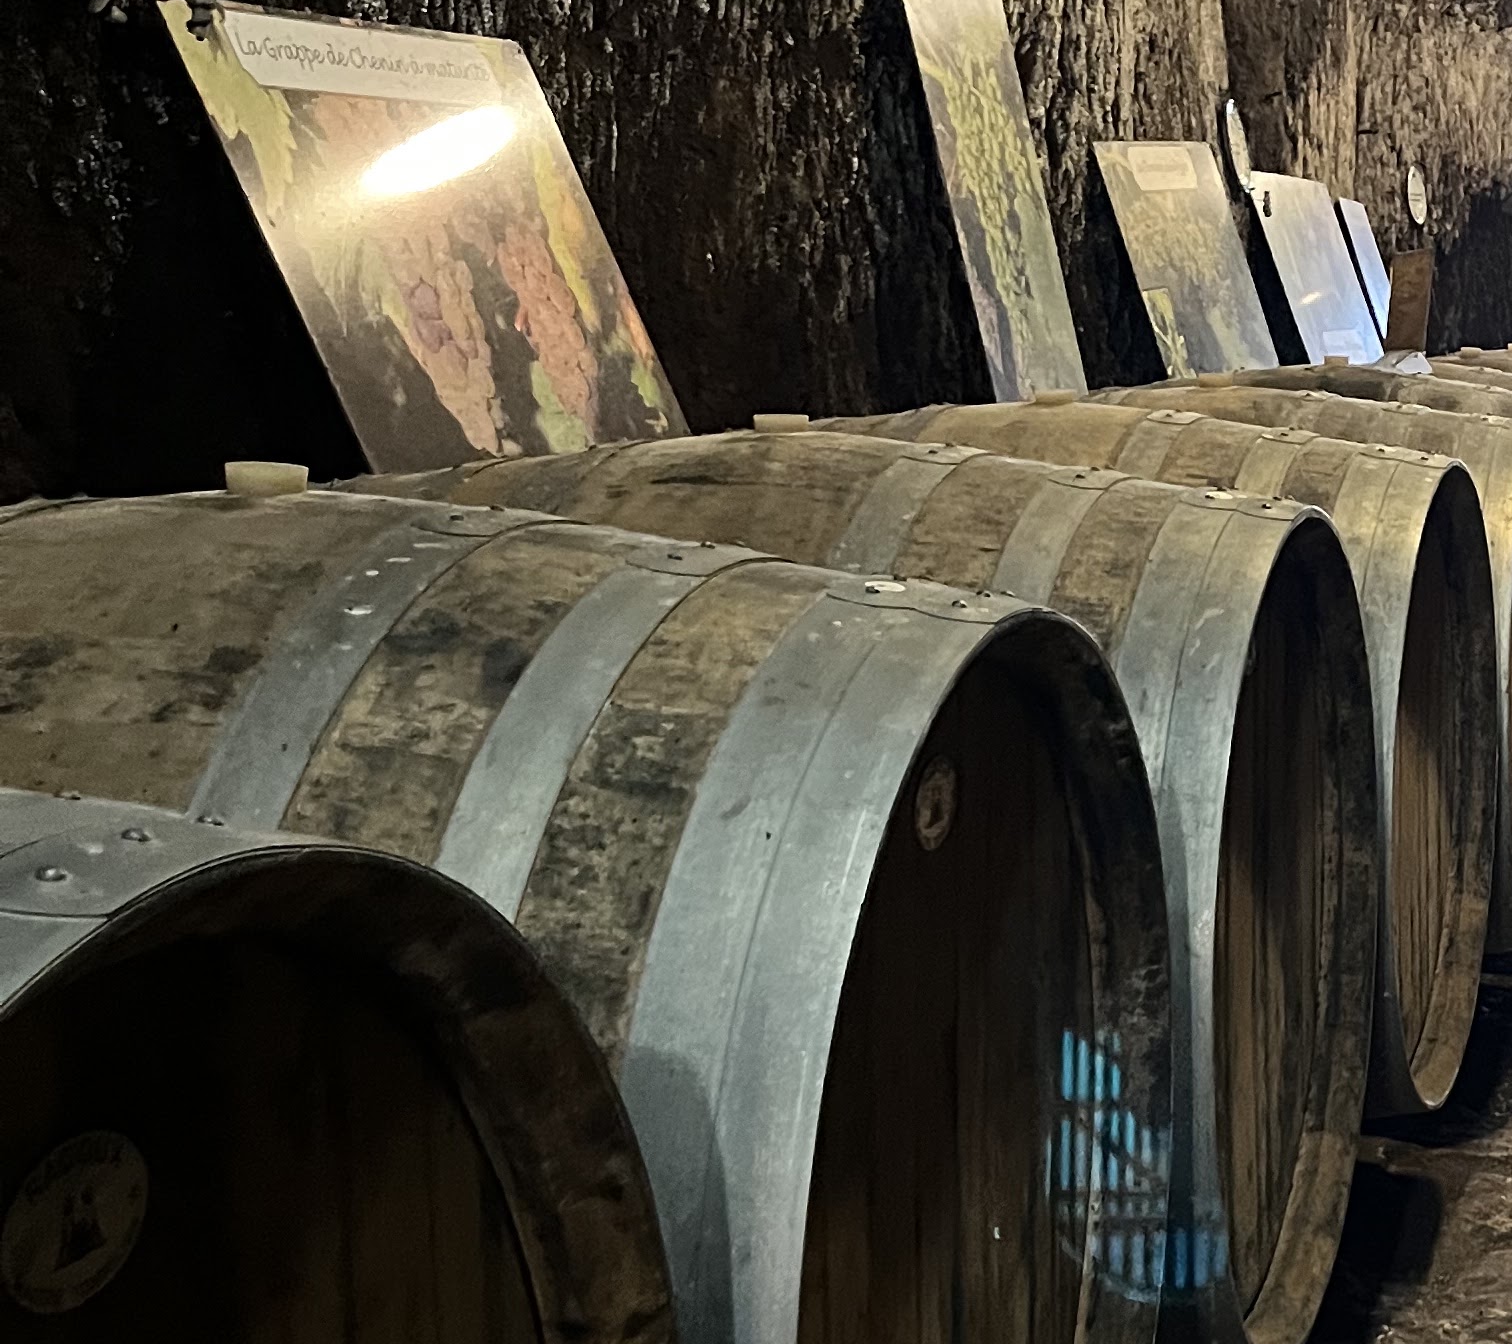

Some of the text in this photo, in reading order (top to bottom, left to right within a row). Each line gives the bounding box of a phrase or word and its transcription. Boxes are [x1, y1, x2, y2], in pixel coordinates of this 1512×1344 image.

[235, 32, 261, 56] La
[263, 38, 324, 73] Grappe
[325, 42, 350, 66] de
[350, 47, 408, 74] Chenin
